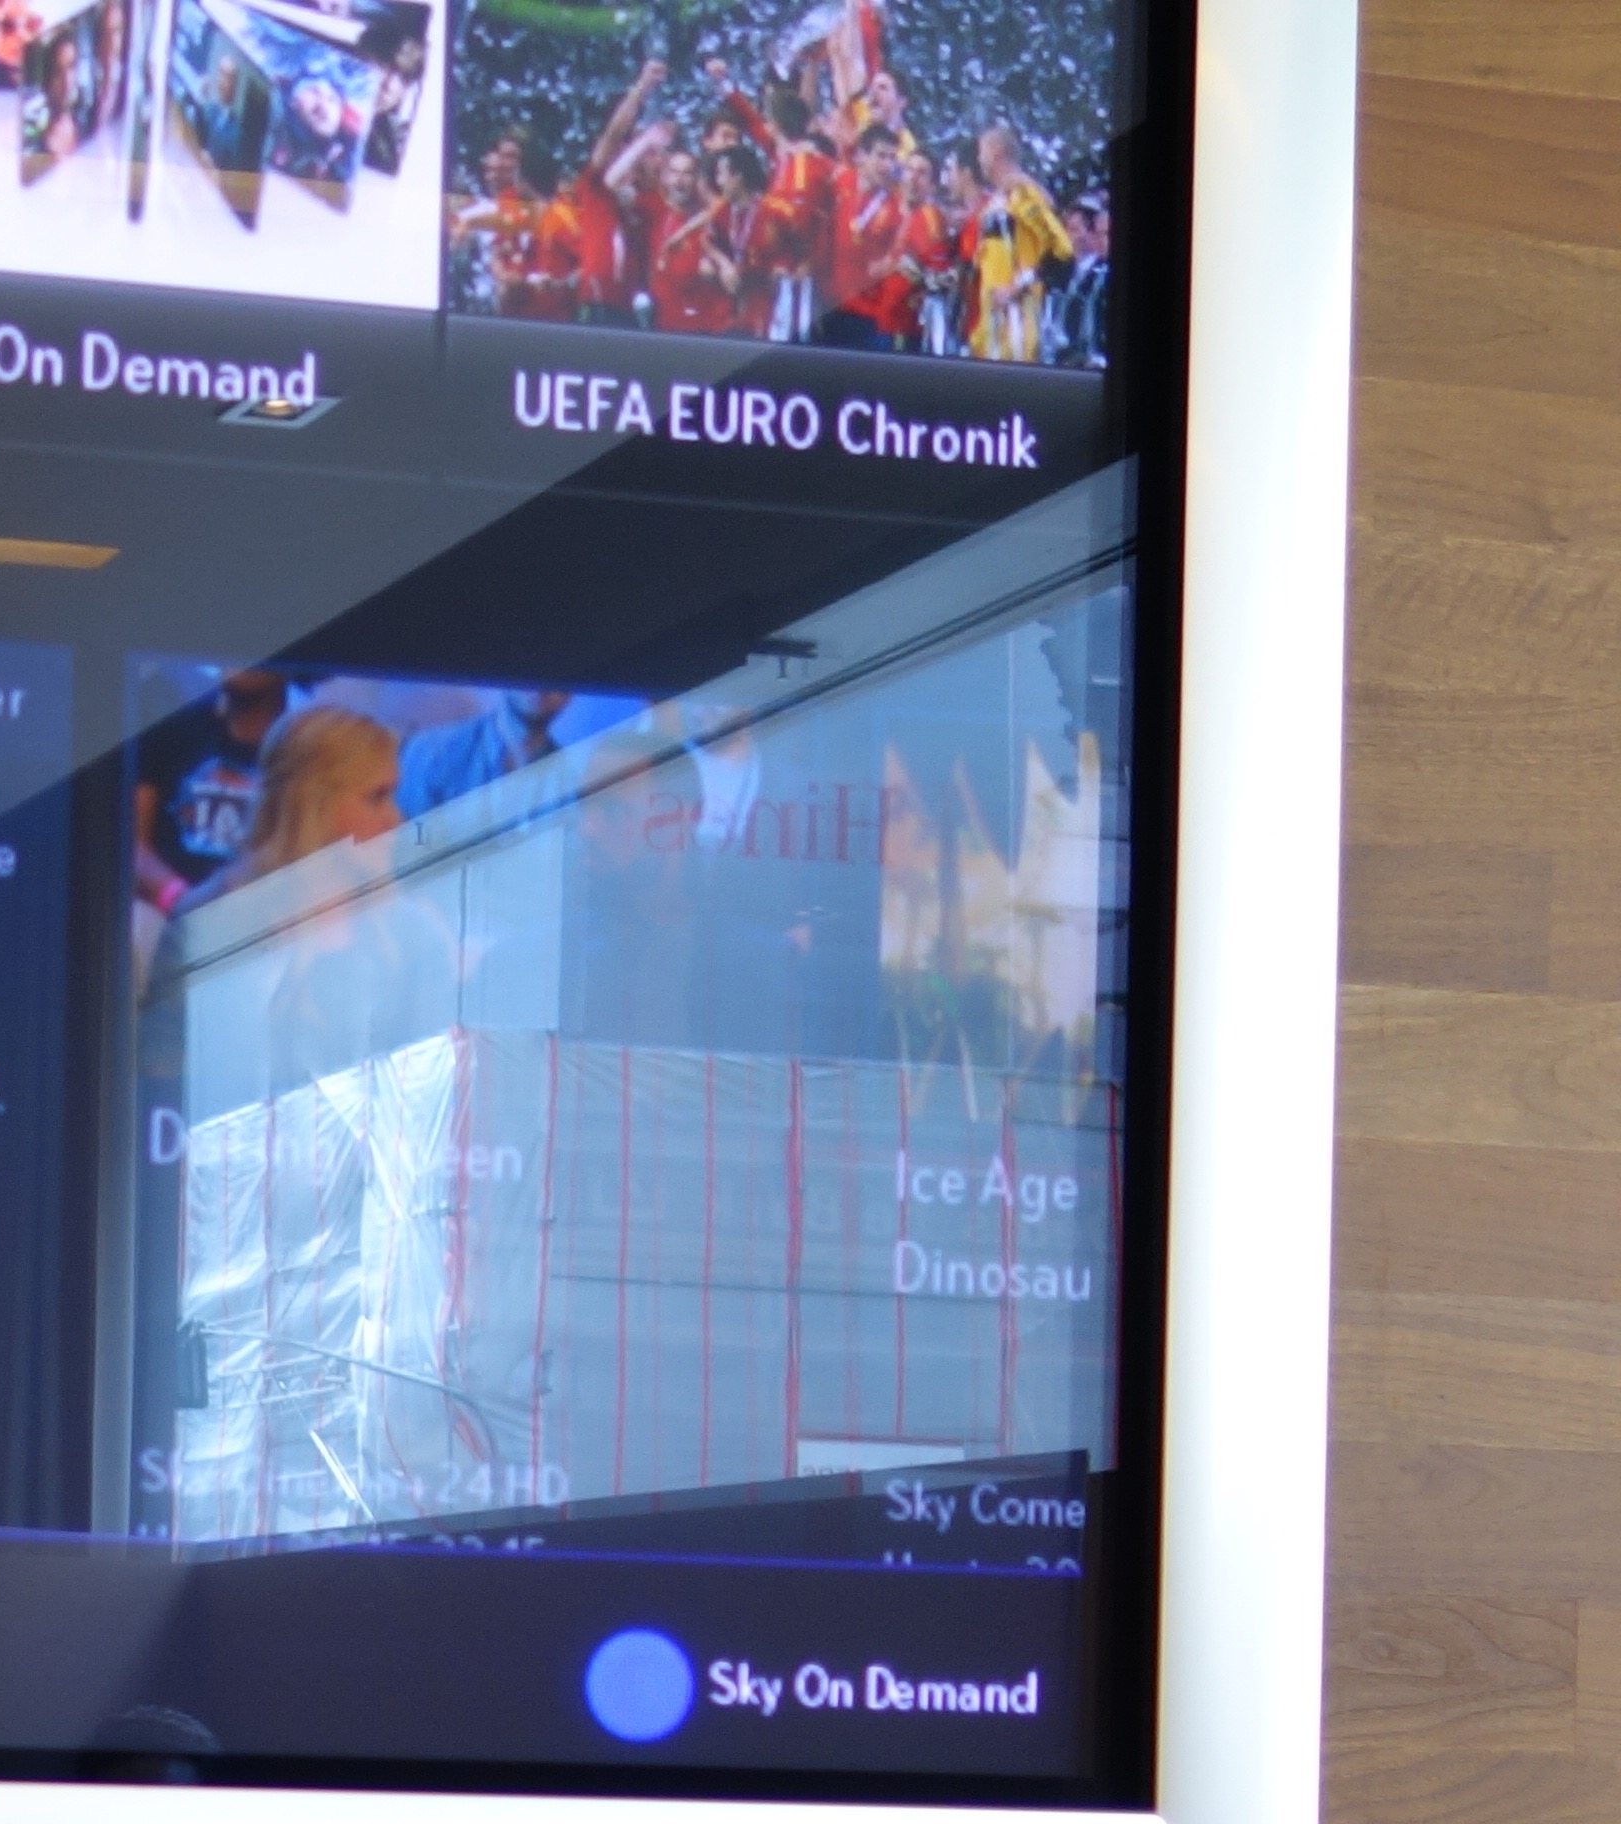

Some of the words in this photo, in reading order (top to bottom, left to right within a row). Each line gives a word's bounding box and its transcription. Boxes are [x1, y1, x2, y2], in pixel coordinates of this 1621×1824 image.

[80, 331, 317, 406] Demand
[513, 370, 654, 435] UEFA
[669, 384, 820, 451] EURO
[837, 401, 1040, 469] Chronik
[895, 1149, 968, 1205] Ice
[979, 1154, 1080, 1224] Age
[892, 1239, 1092, 1302] Dinosau
[885, 1479, 957, 1534] Sky
[969, 1480, 1088, 1530] Come
[707, 1659, 784, 1717] Sky
[794, 1662, 855, 1710] On
[866, 1664, 1040, 1716] Demand
